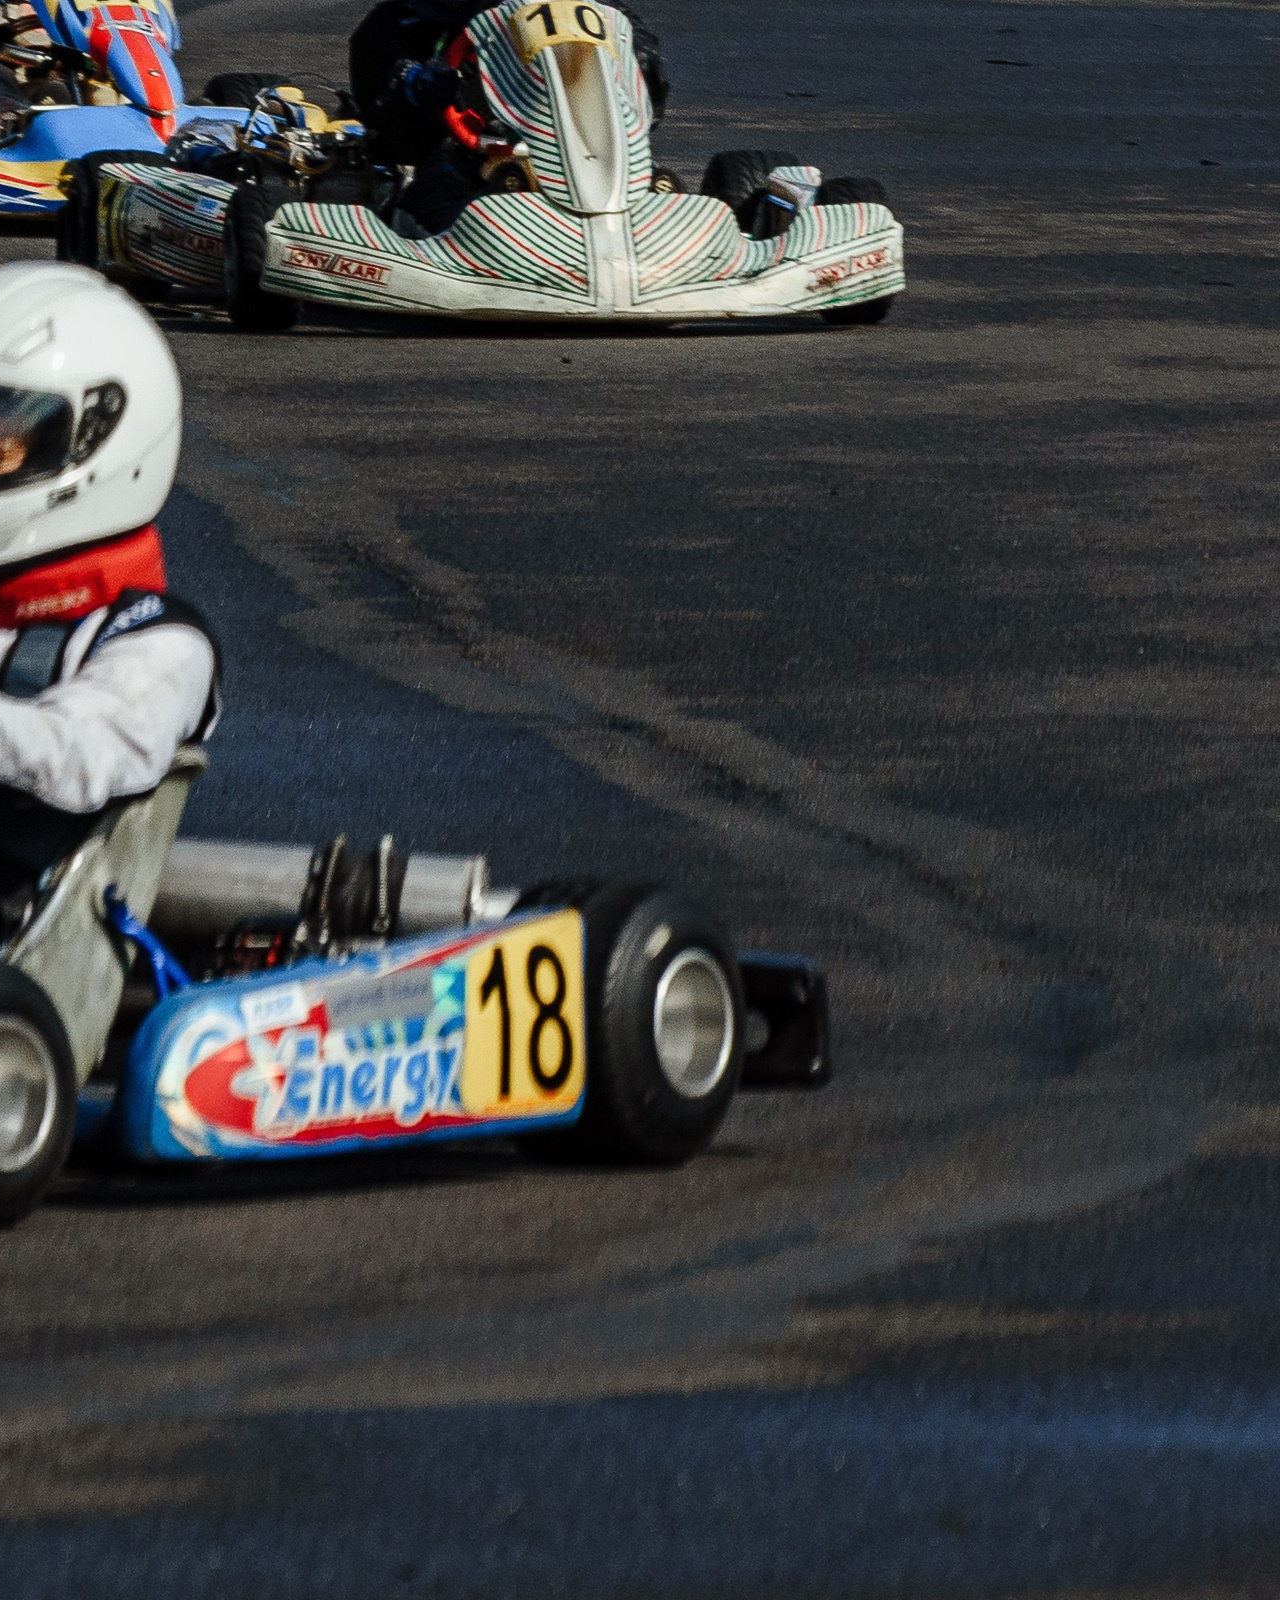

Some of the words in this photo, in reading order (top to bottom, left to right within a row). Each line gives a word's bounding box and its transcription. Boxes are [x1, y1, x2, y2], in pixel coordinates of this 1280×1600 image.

[526, 3, 606, 40] 10
[479, 943, 574, 1103] 18
[267, 1032, 460, 1126] Energy
